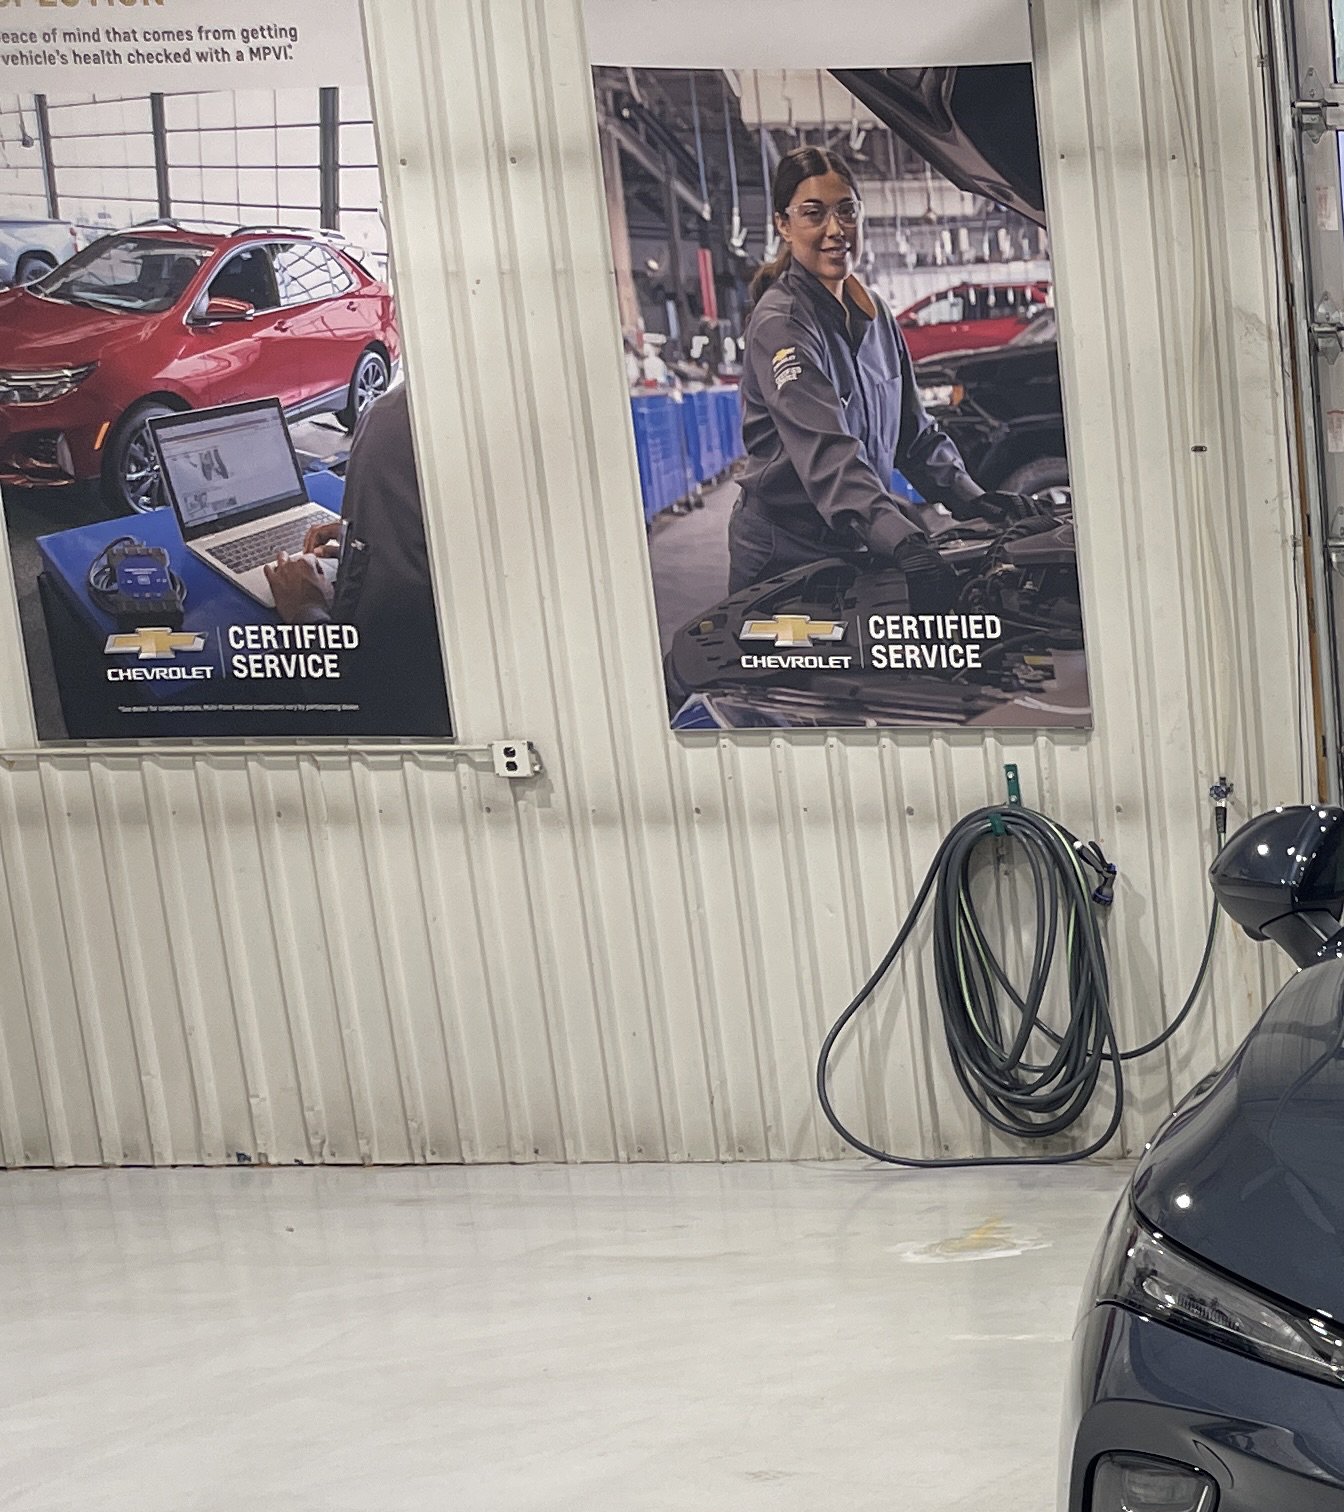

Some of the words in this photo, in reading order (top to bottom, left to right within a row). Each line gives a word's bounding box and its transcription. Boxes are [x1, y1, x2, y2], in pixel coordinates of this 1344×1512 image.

[0, 31, 38, 44] eace
[42, 28, 57, 43] of
[63, 27, 101, 43] mind
[105, 27, 139, 43] that
[143, 29, 194, 42] comes
[197, 25, 236, 40] from
[241, 24, 298, 44] getting
[1, 49, 69, 65] vehicle's
[72, 49, 122, 65] health
[127, 48, 191, 65] checked
[195, 46, 231, 62] with
[236, 50, 245, 61] a
[228, 624, 359, 650] CERTIFIED
[868, 614, 1001, 640] CERTIFIED
[232, 653, 340, 679] SERVICE
[741, 655, 852, 669] CHEVROLET
[871, 644, 982, 669] SERVICE
[107, 666, 214, 681] CHEVROLET
